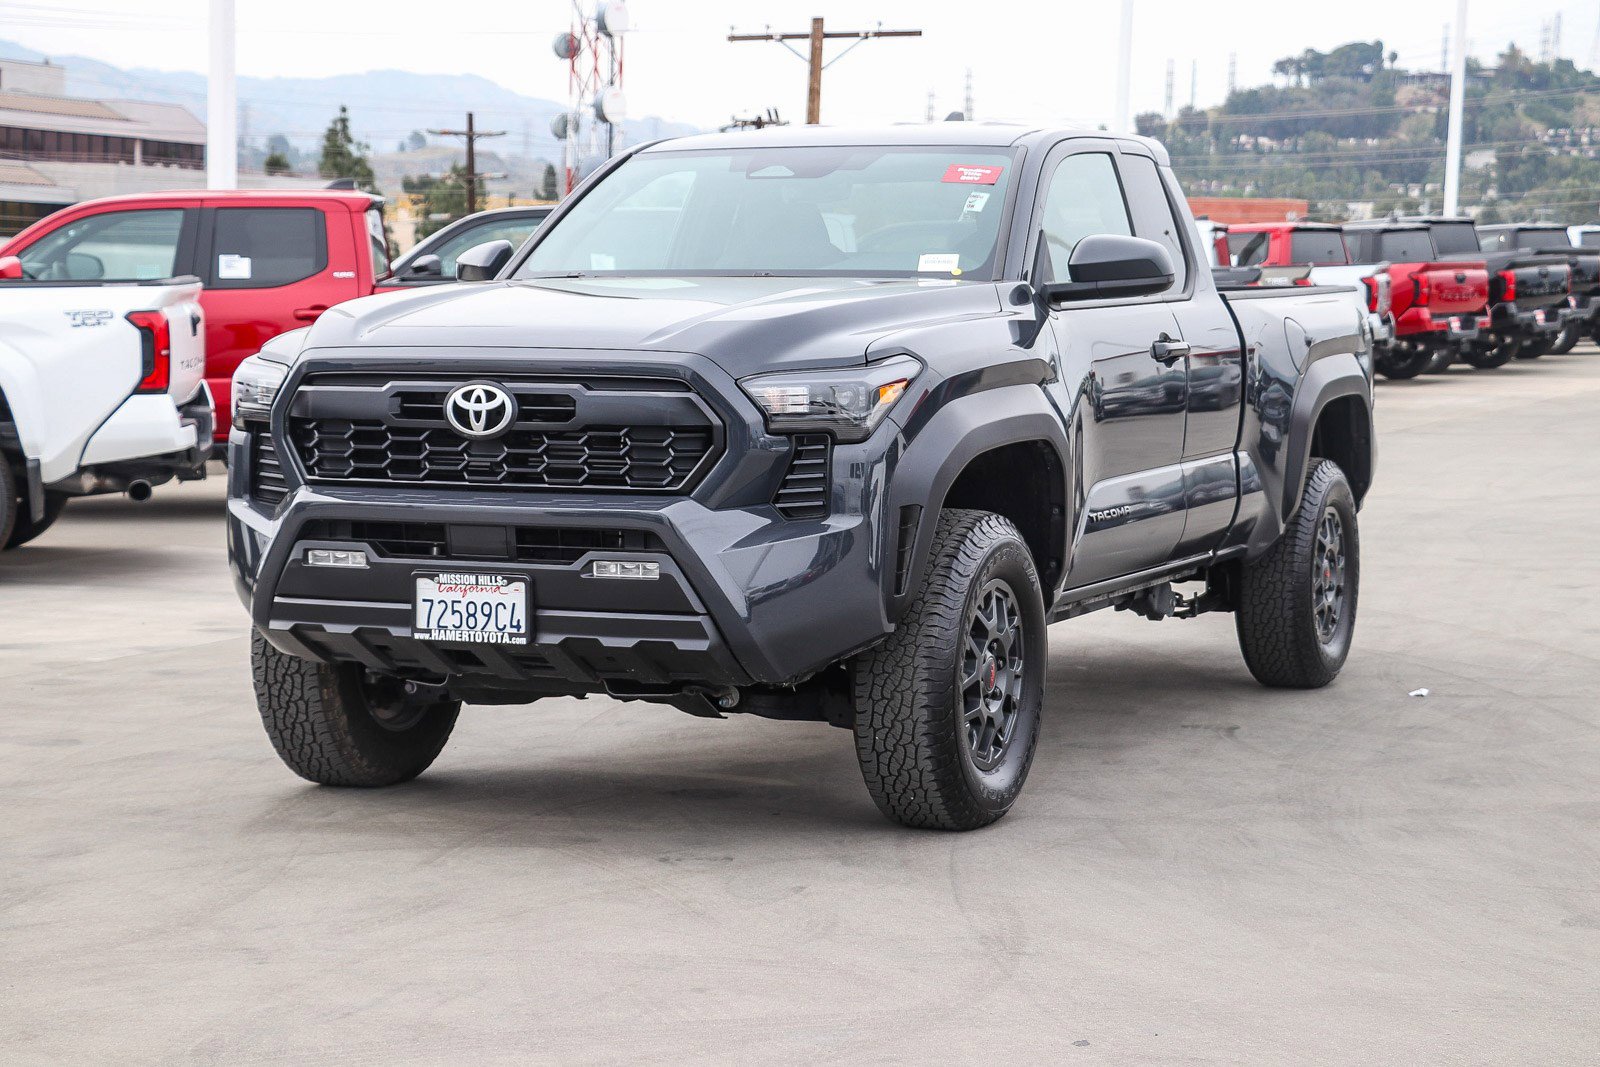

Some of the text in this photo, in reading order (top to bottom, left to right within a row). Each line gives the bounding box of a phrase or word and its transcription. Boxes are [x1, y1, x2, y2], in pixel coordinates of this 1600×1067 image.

[1089, 506, 1131, 522] TACOMA
[439, 573, 503, 586] MISSION HILLS
[438, 582, 508, 598] California
[422, 598, 522, 632] 72589C4
[413, 629, 527, 645] www.HAMERTOYOTA.com
